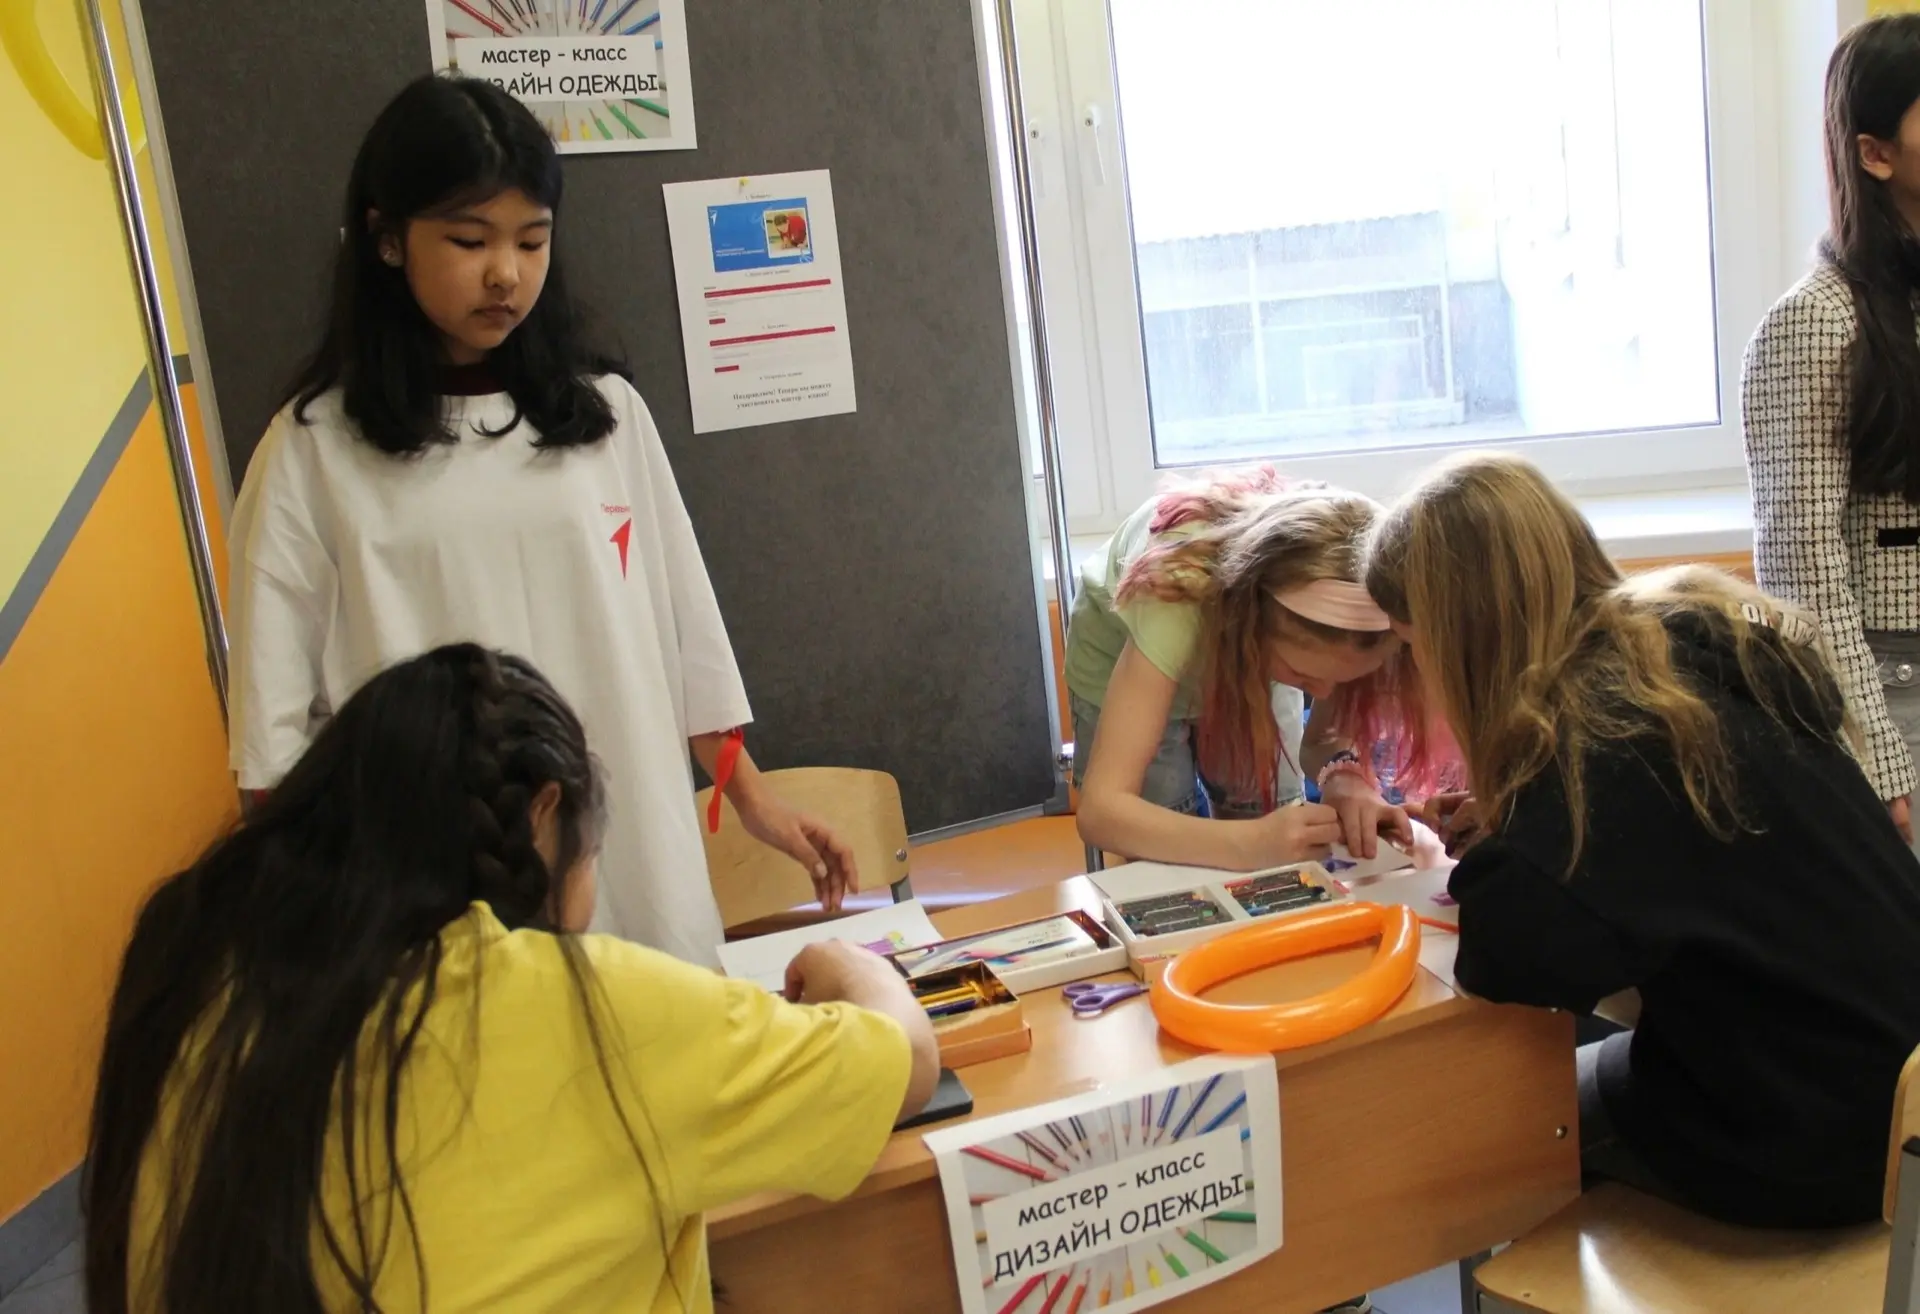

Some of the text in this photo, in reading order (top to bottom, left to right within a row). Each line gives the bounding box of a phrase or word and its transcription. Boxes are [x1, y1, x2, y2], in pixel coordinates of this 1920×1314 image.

[481, 48, 551, 67] мастер
[572, 47, 628, 62] класс
[487, 72, 658, 96] ЗАЙН ОДЕЖДЫ
[1018, 1151, 1206, 1227] мастер - класс
[993, 1174, 1245, 1282] ДИЗАЙН ОДЕЖДЫ
